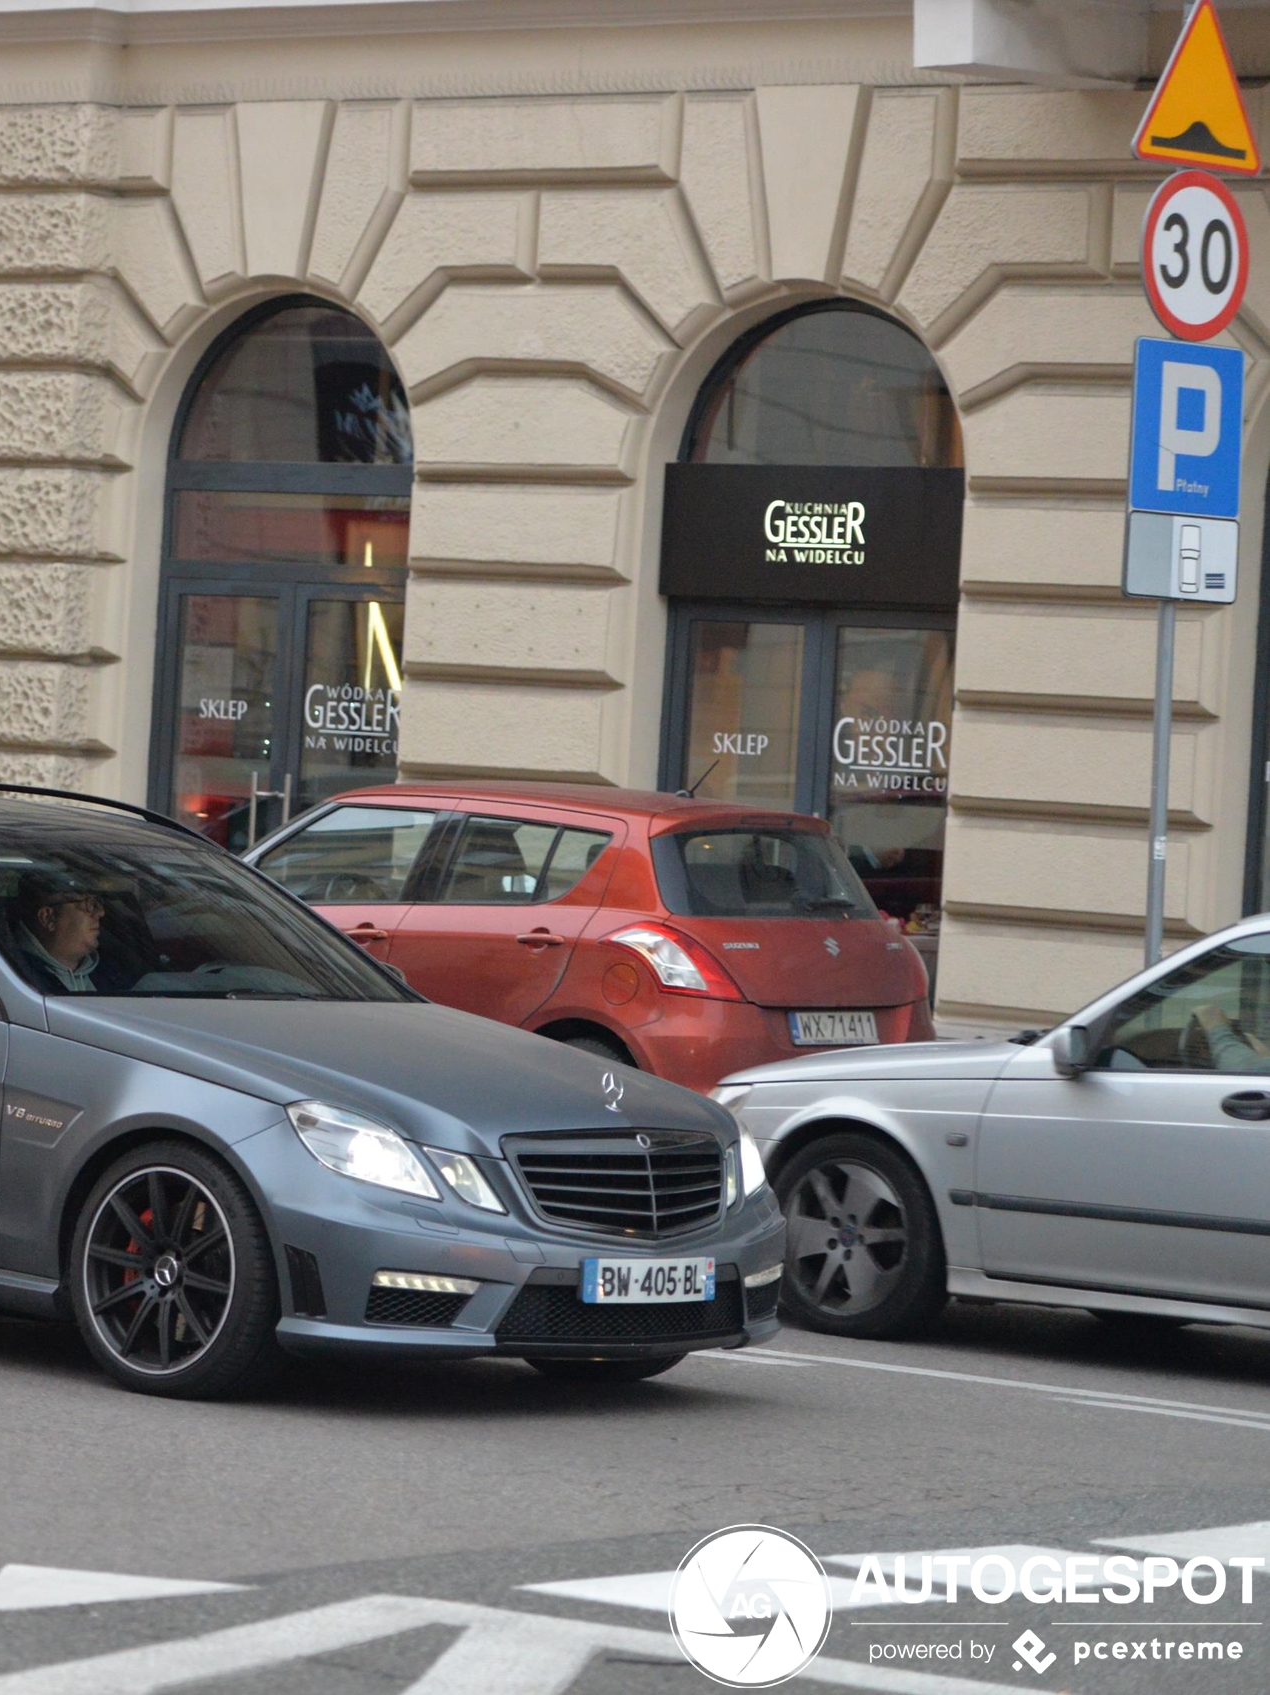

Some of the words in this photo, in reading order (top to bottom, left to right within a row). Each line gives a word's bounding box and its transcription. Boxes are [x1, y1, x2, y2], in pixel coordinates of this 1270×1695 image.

[1160, 213, 1232, 295] 30
[1158, 361, 1222, 491] P
[785, 503, 848, 515] KUCHNIA
[764, 500, 866, 544] GESSLER
[765, 549, 788, 562] NA
[793, 549, 865, 565] WIDELCU
[326, 684, 385, 702] WÓDKA
[199, 699, 248, 720] SKLEP
[857, 717, 925, 736] WÓDKA
[305, 736, 327, 749] NA
[714, 732, 768, 755] SKLEP
[833, 717, 947, 768] GESSLER
[834, 773, 858, 787] NA
[866, 774, 947, 793] WIDELCU
[799, 1015, 825, 1038] WX
[827, 1015, 875, 1038] 71411
[7, 1104, 26, 1118] V8
[26, 1113, 63, 1129] BITURBO
